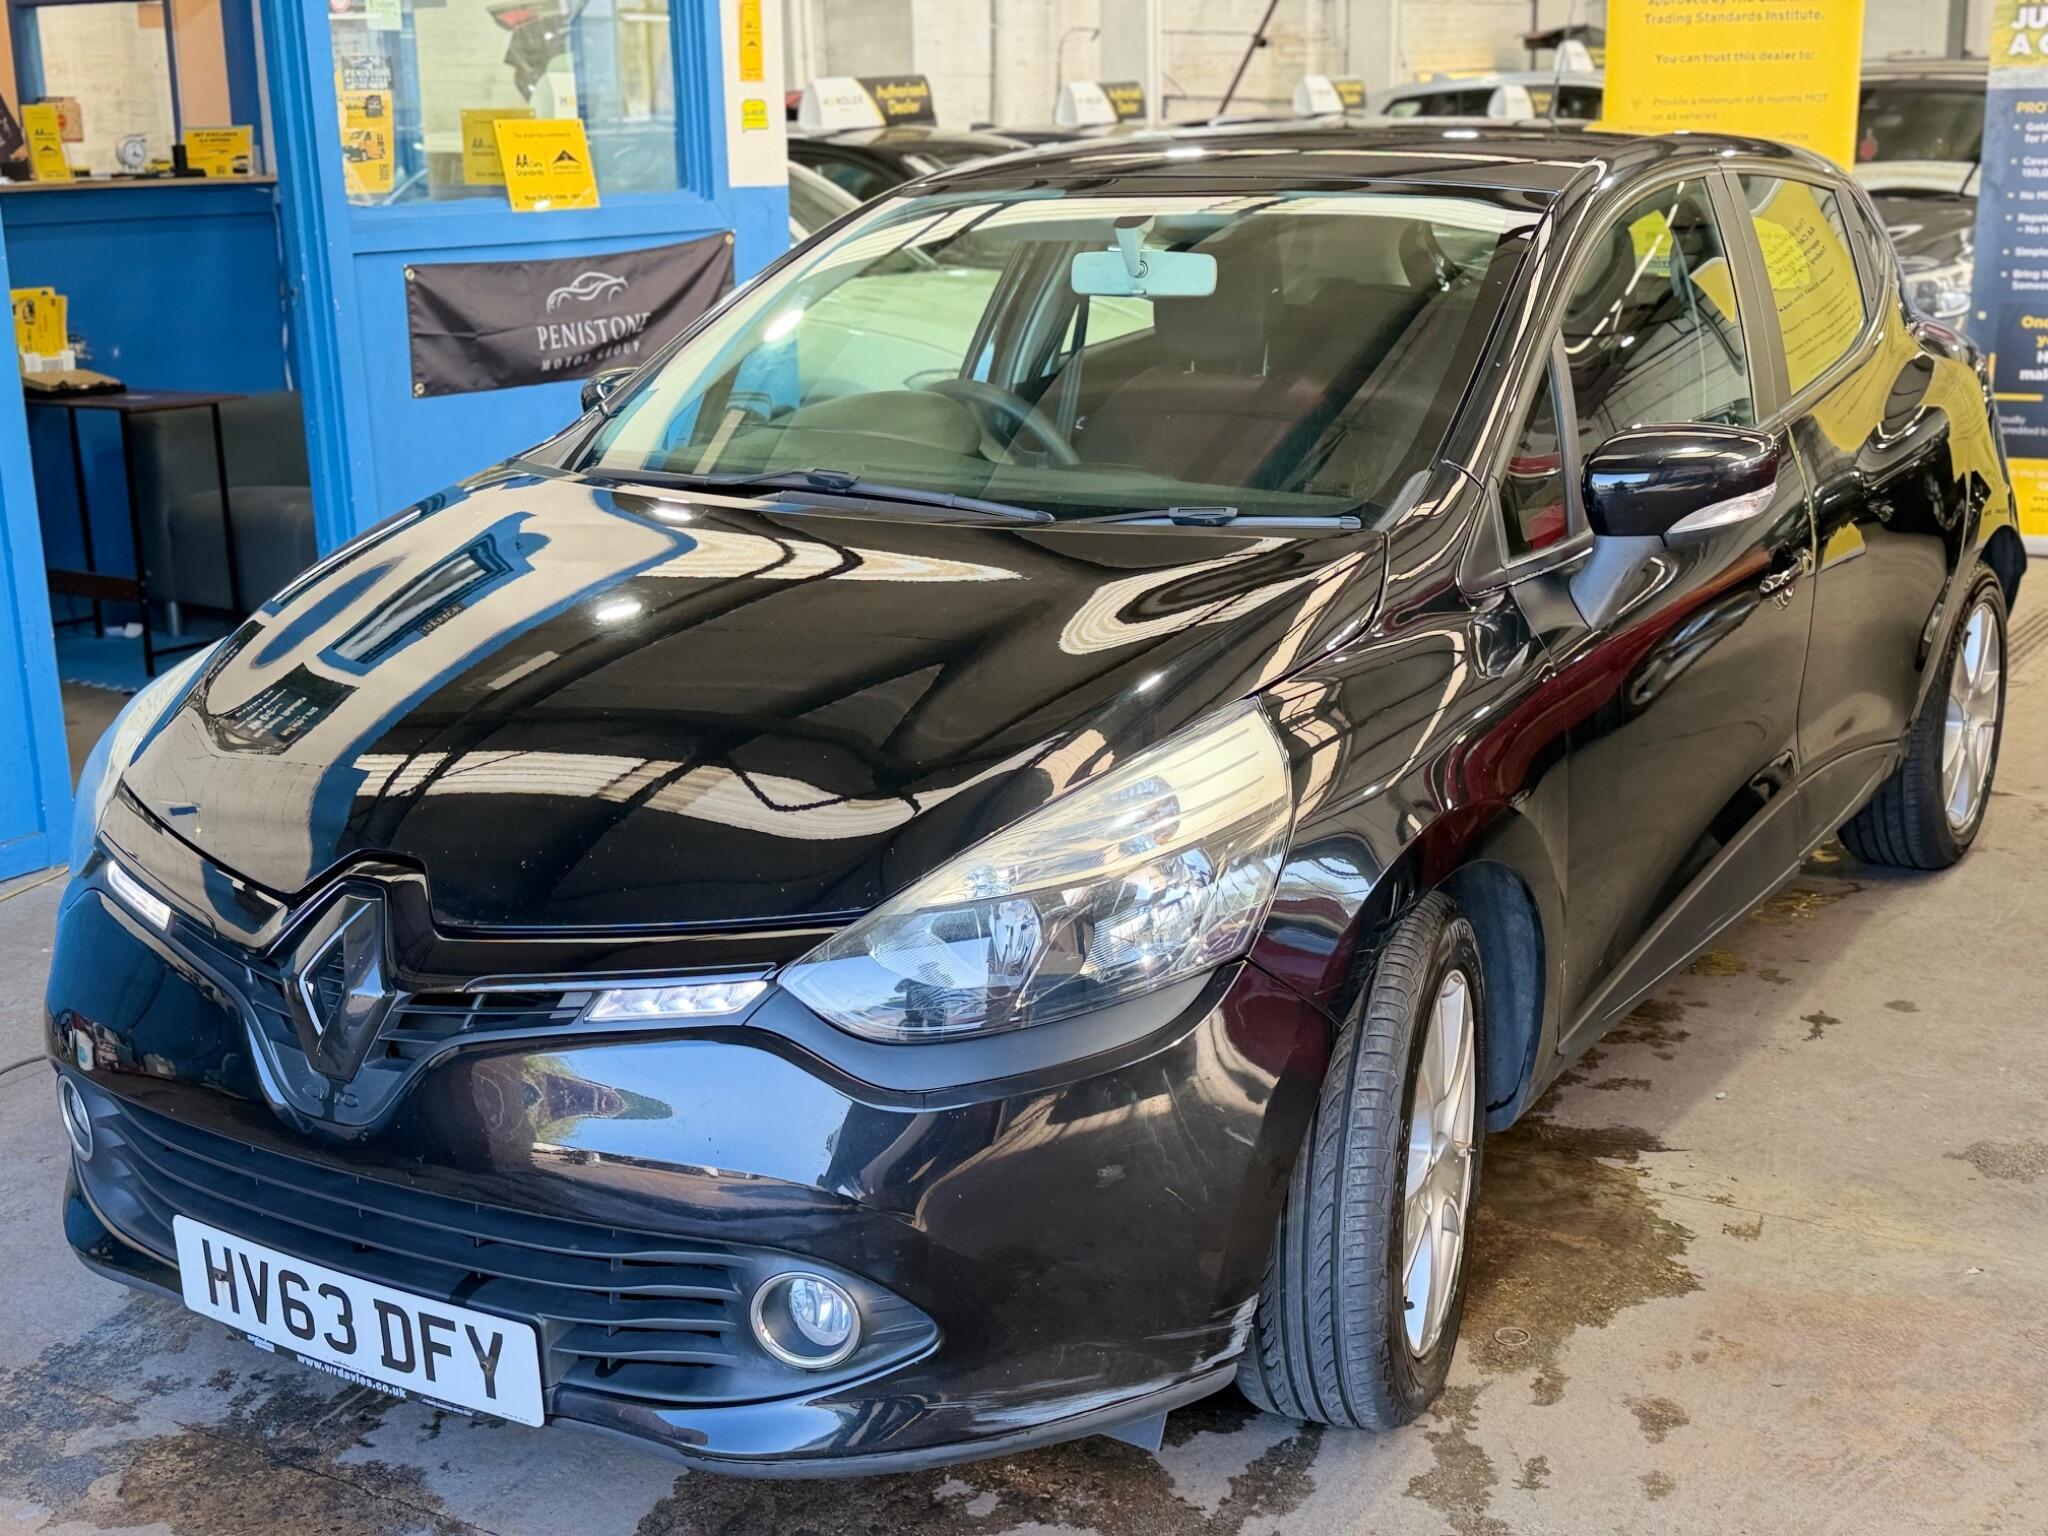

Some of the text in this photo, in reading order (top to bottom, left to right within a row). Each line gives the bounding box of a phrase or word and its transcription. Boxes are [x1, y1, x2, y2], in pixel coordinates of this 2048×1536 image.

[1645, 10, 1825, 25] Trading Standards Institute.
[2007, 32, 2032, 56] A
[1655, 51, 1815, 64] You can trust this dealer to:
[2016, 101, 2048, 114] PRO
[537, 312, 650, 350] PENISTONE
[202, 1238, 503, 1400] HV63 DFY
